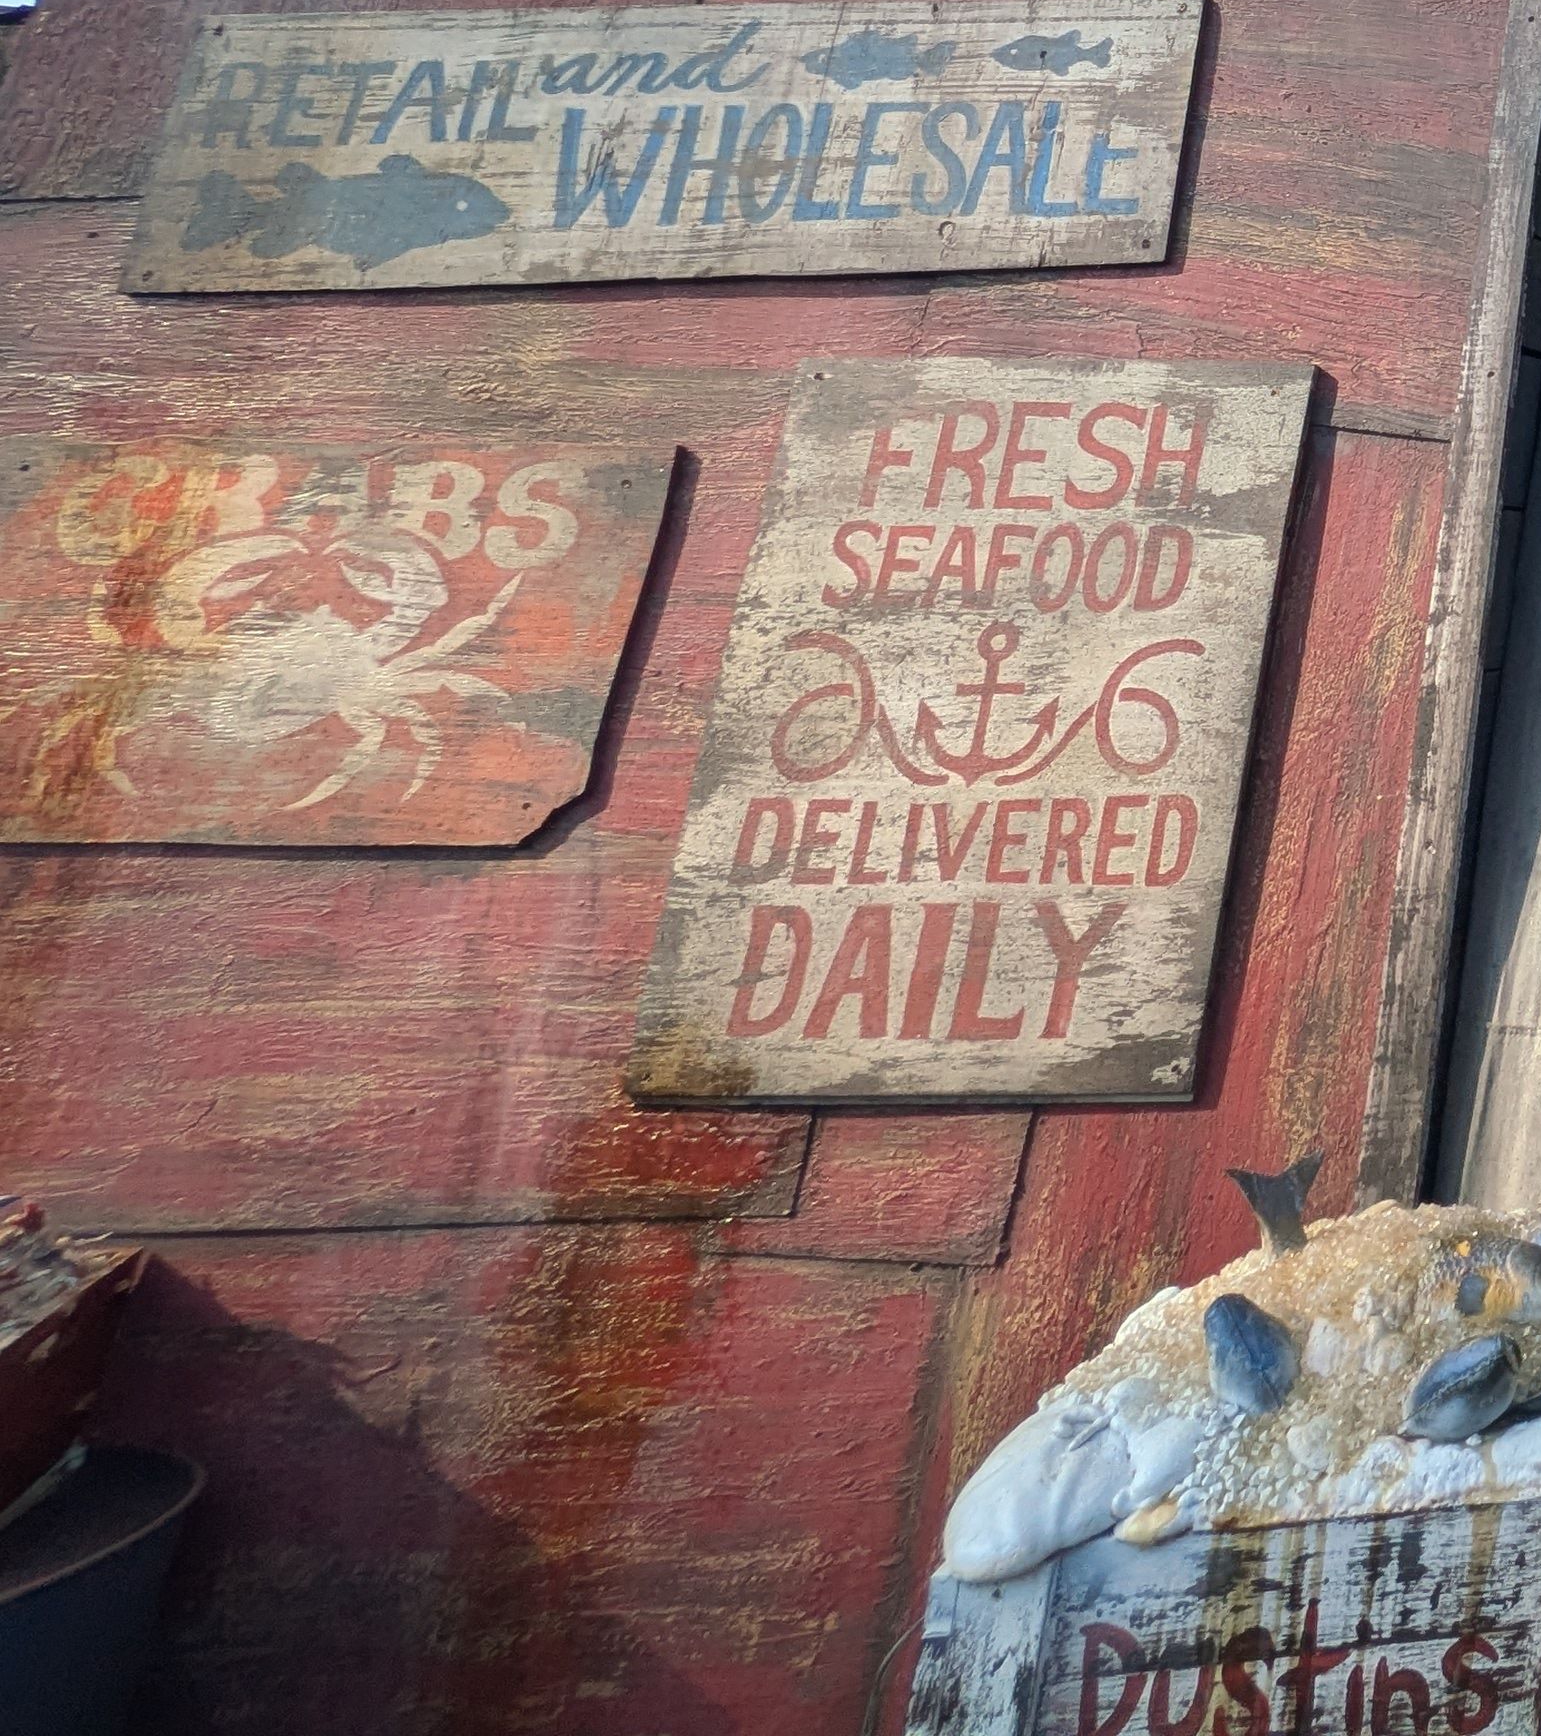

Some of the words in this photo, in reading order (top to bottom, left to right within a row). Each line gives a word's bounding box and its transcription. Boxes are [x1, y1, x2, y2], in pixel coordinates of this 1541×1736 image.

[196, 58, 537, 150] RETAIL
[539, 21, 768, 97] and
[552, 100, 1142, 228] WHOLESALE
[56, 450, 580, 570] CRABS
[856, 400, 1210, 510] FRESH
[821, 519, 1194, 613] SEAFOOD
[730, 793, 1201, 888] DELIVERED
[726, 899, 1126, 1040] DAILY
